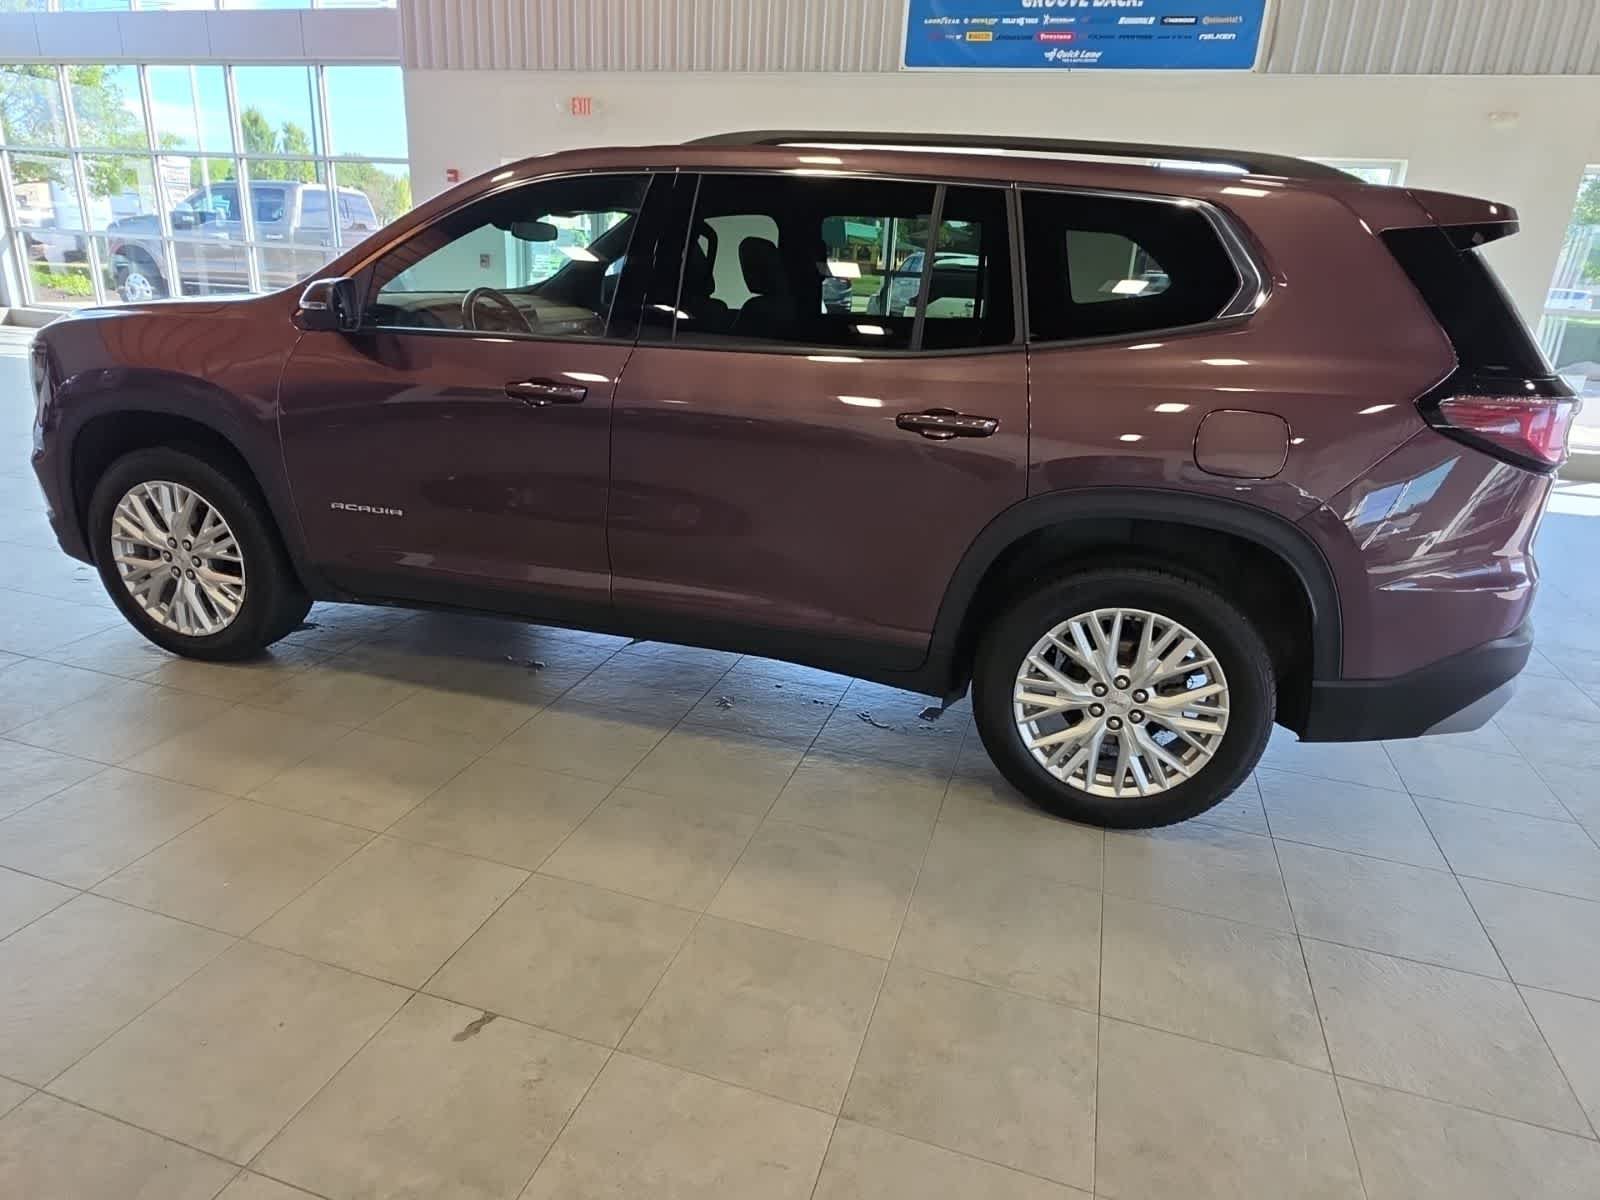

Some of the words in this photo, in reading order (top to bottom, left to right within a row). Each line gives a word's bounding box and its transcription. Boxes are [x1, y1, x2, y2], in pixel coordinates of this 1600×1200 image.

[1056, 49, 1080, 59] Quick
[571, 97, 592, 115] EXIT
[330, 502, 403, 516] ACADIA
